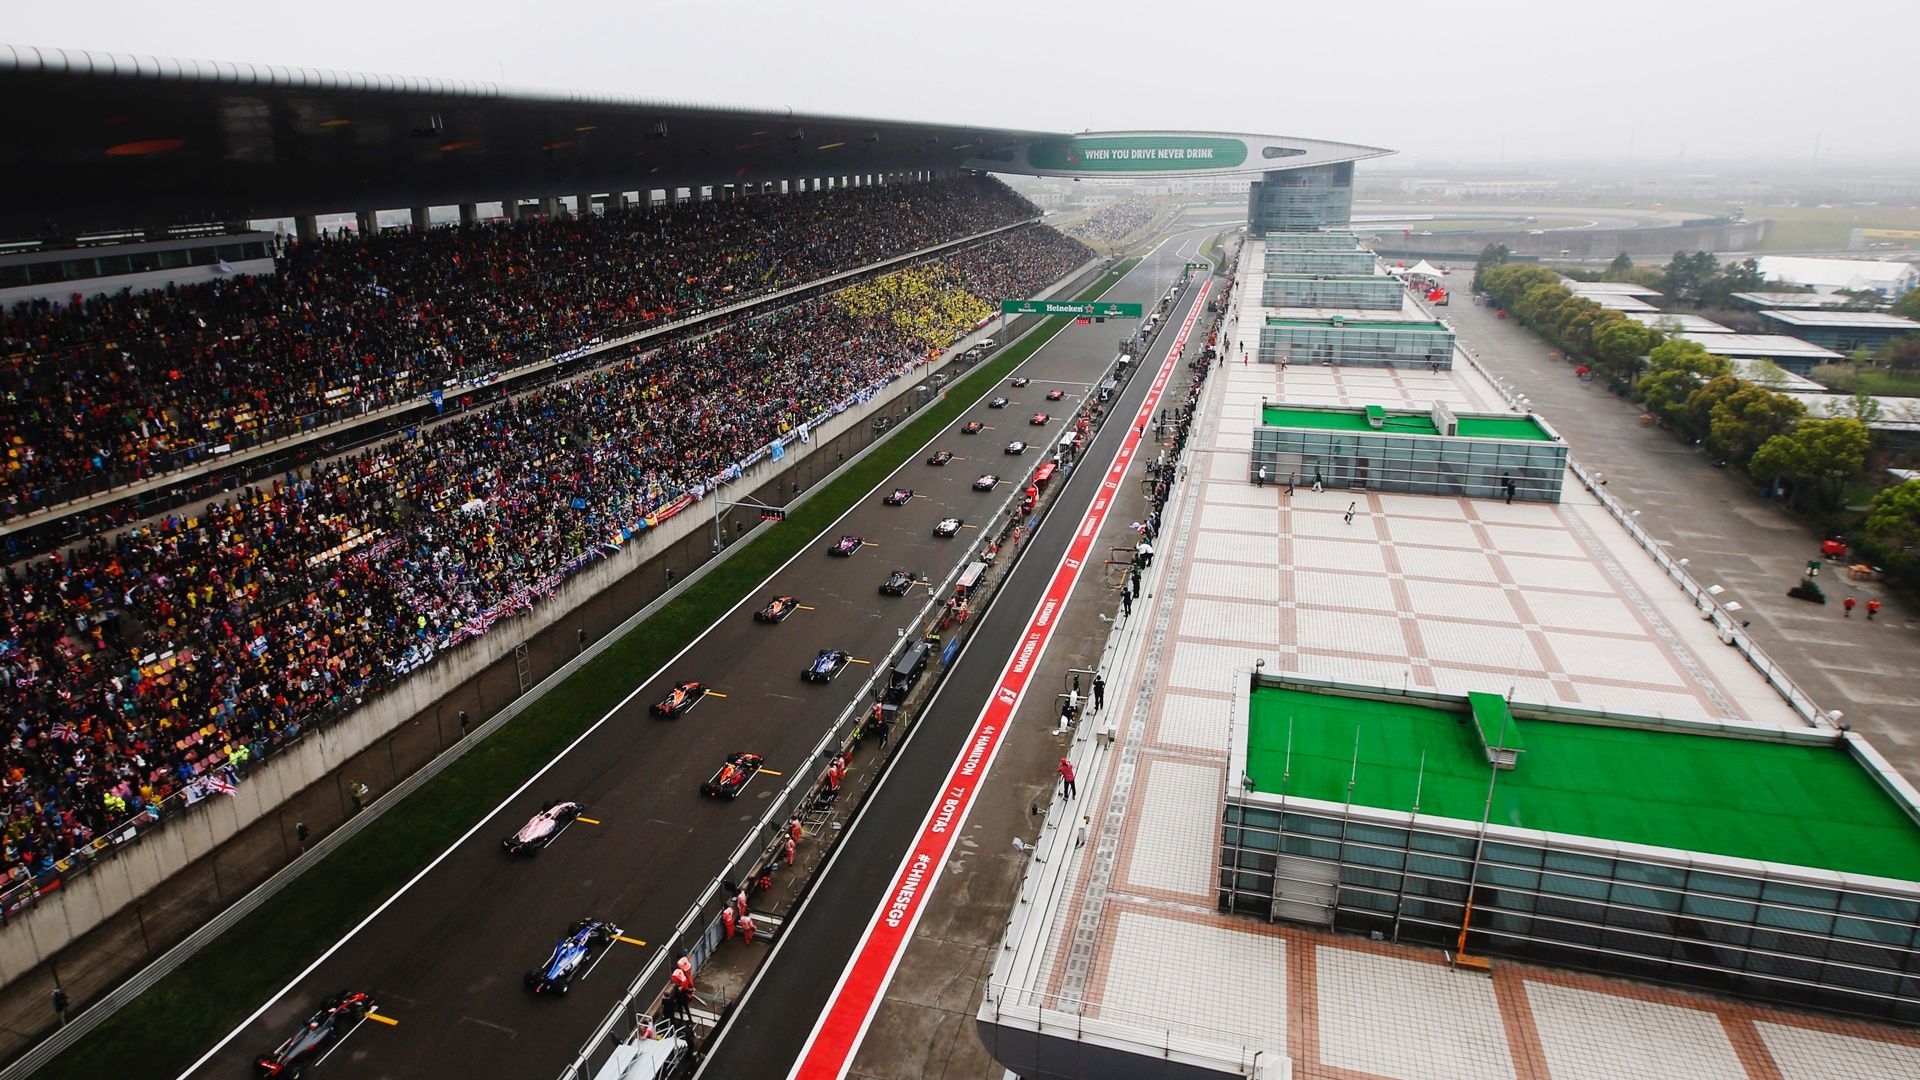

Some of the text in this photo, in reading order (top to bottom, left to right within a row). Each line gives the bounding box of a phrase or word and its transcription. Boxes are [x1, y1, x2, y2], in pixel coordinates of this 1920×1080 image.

[1085, 148, 1213, 160] WHEN YOU DRIVE NEVER DRINK
[1046, 304, 1084, 313] Heineken
[1012, 639, 1038, 673] VERSTAPPEN
[960, 725, 995, 776] 44 HAMILTON
[931, 786, 965, 833] 77 BOTTAS
[885, 853, 931, 928] #CHINESEGP
